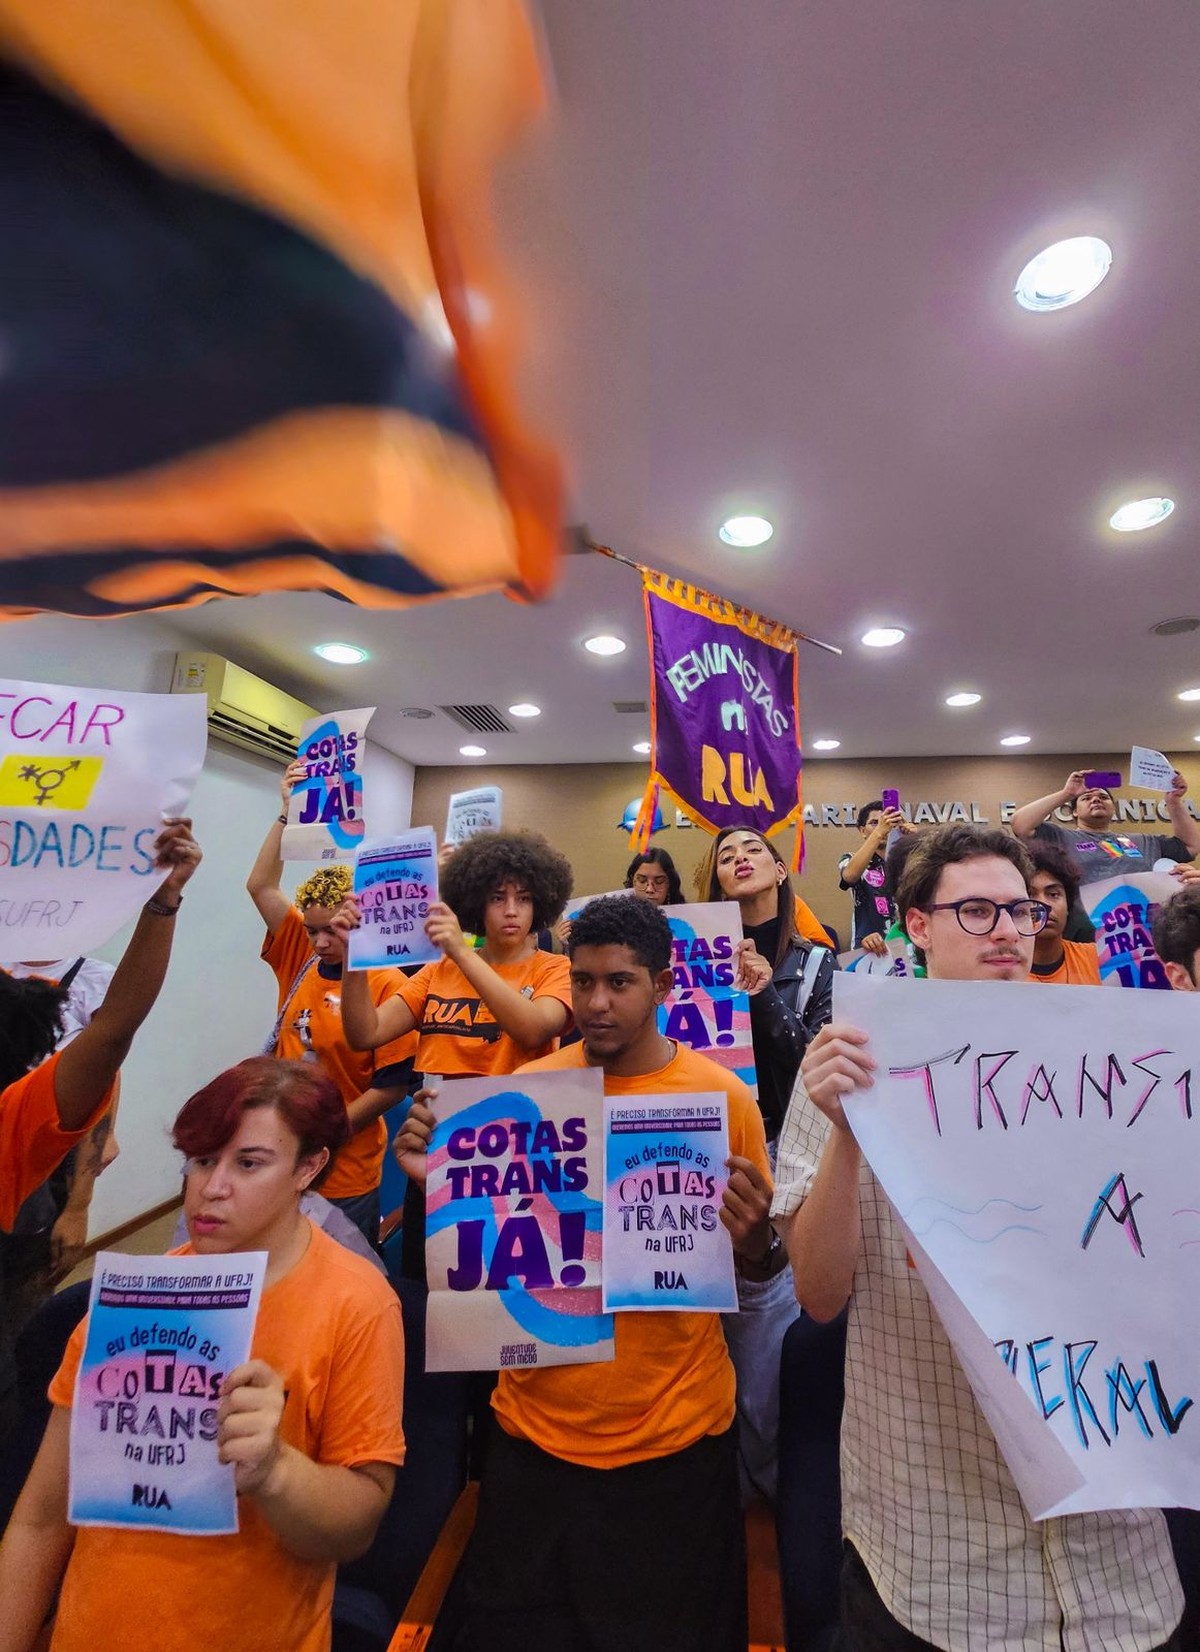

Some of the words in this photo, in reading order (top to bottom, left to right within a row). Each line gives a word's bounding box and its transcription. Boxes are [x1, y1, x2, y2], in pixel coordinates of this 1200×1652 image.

[666, 643, 789, 737] FEMINSTAS
[721, 699, 749, 735] n
[702, 744, 775, 812] RUA
[900, 801, 989, 823] NAVAL
[375, 867, 410, 880] defendo
[361, 879, 428, 907] COTAS
[361, 902, 430, 924] TRANS
[380, 926, 391, 935] na
[393, 921, 414, 934] UFRJ
[386, 944, 411, 956] RUA
[672, 936, 733, 961] TAS
[672, 963, 735, 989] ANS
[423, 999, 473, 1026] RUA
[617, 1109, 645, 1119] PRECISO
[648, 1107, 694, 1118] TRANSFORMAR
[447, 1117, 587, 1161] COTAS
[625, 1153, 640, 1170] eu
[642, 1142, 692, 1162] defendo
[695, 1152, 710, 1168] as
[446, 1157, 589, 1201] TRANS
[619, 1160, 716, 1205] COTAS
[618, 1204, 717, 1232] TRANS
[1081, 1172, 1144, 1258] A
[447, 1198, 587, 1291] JÁ!
[645, 1238, 660, 1252] na
[666, 1234, 694, 1252] UFRJ
[108, 1275, 144, 1288] PRECISO
[146, 1275, 213, 1289] TRANSFORMAR
[214, 1274, 222, 1287] A
[225, 1273, 254, 1287] UFRJ!
[654, 1271, 688, 1290] RUA
[106, 1337, 125, 1357] eu
[130, 1323, 197, 1349] defendo
[199, 1340, 220, 1361] as
[97, 1349, 225, 1400] COTAS
[94, 1401, 219, 1441] TRANS
[125, 1443, 143, 1462] na
[148, 1444, 185, 1466] UFRJ
[132, 1484, 171, 1510] RUA
